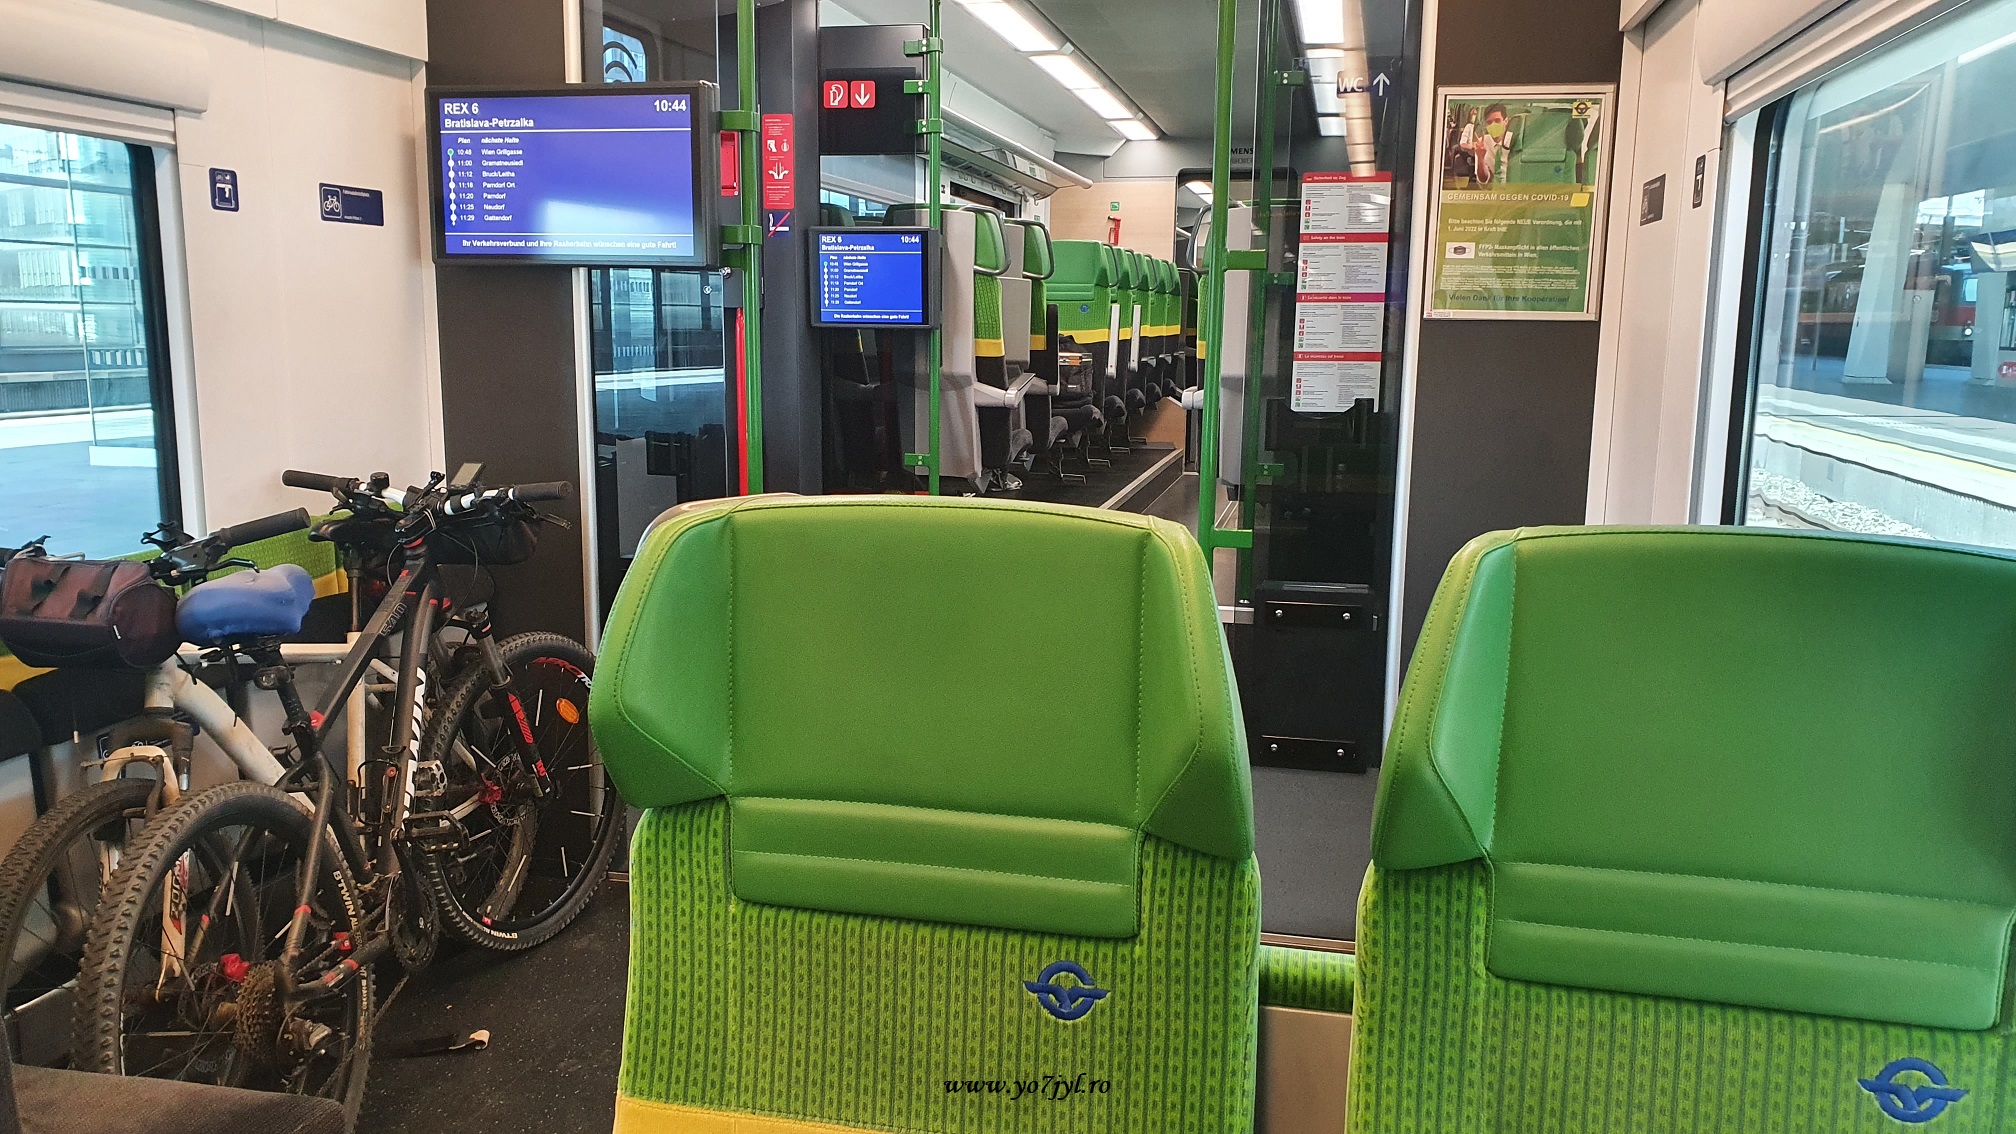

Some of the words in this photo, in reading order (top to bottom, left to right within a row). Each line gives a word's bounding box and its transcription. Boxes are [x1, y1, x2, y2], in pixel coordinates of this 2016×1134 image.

[1338, 76, 1363, 92] WC
[444, 102, 469, 114] REX
[472, 102, 479, 114] 6
[654, 99, 687, 112] 10:44
[444, 118, 534, 128] Bratislava-Petrzalka
